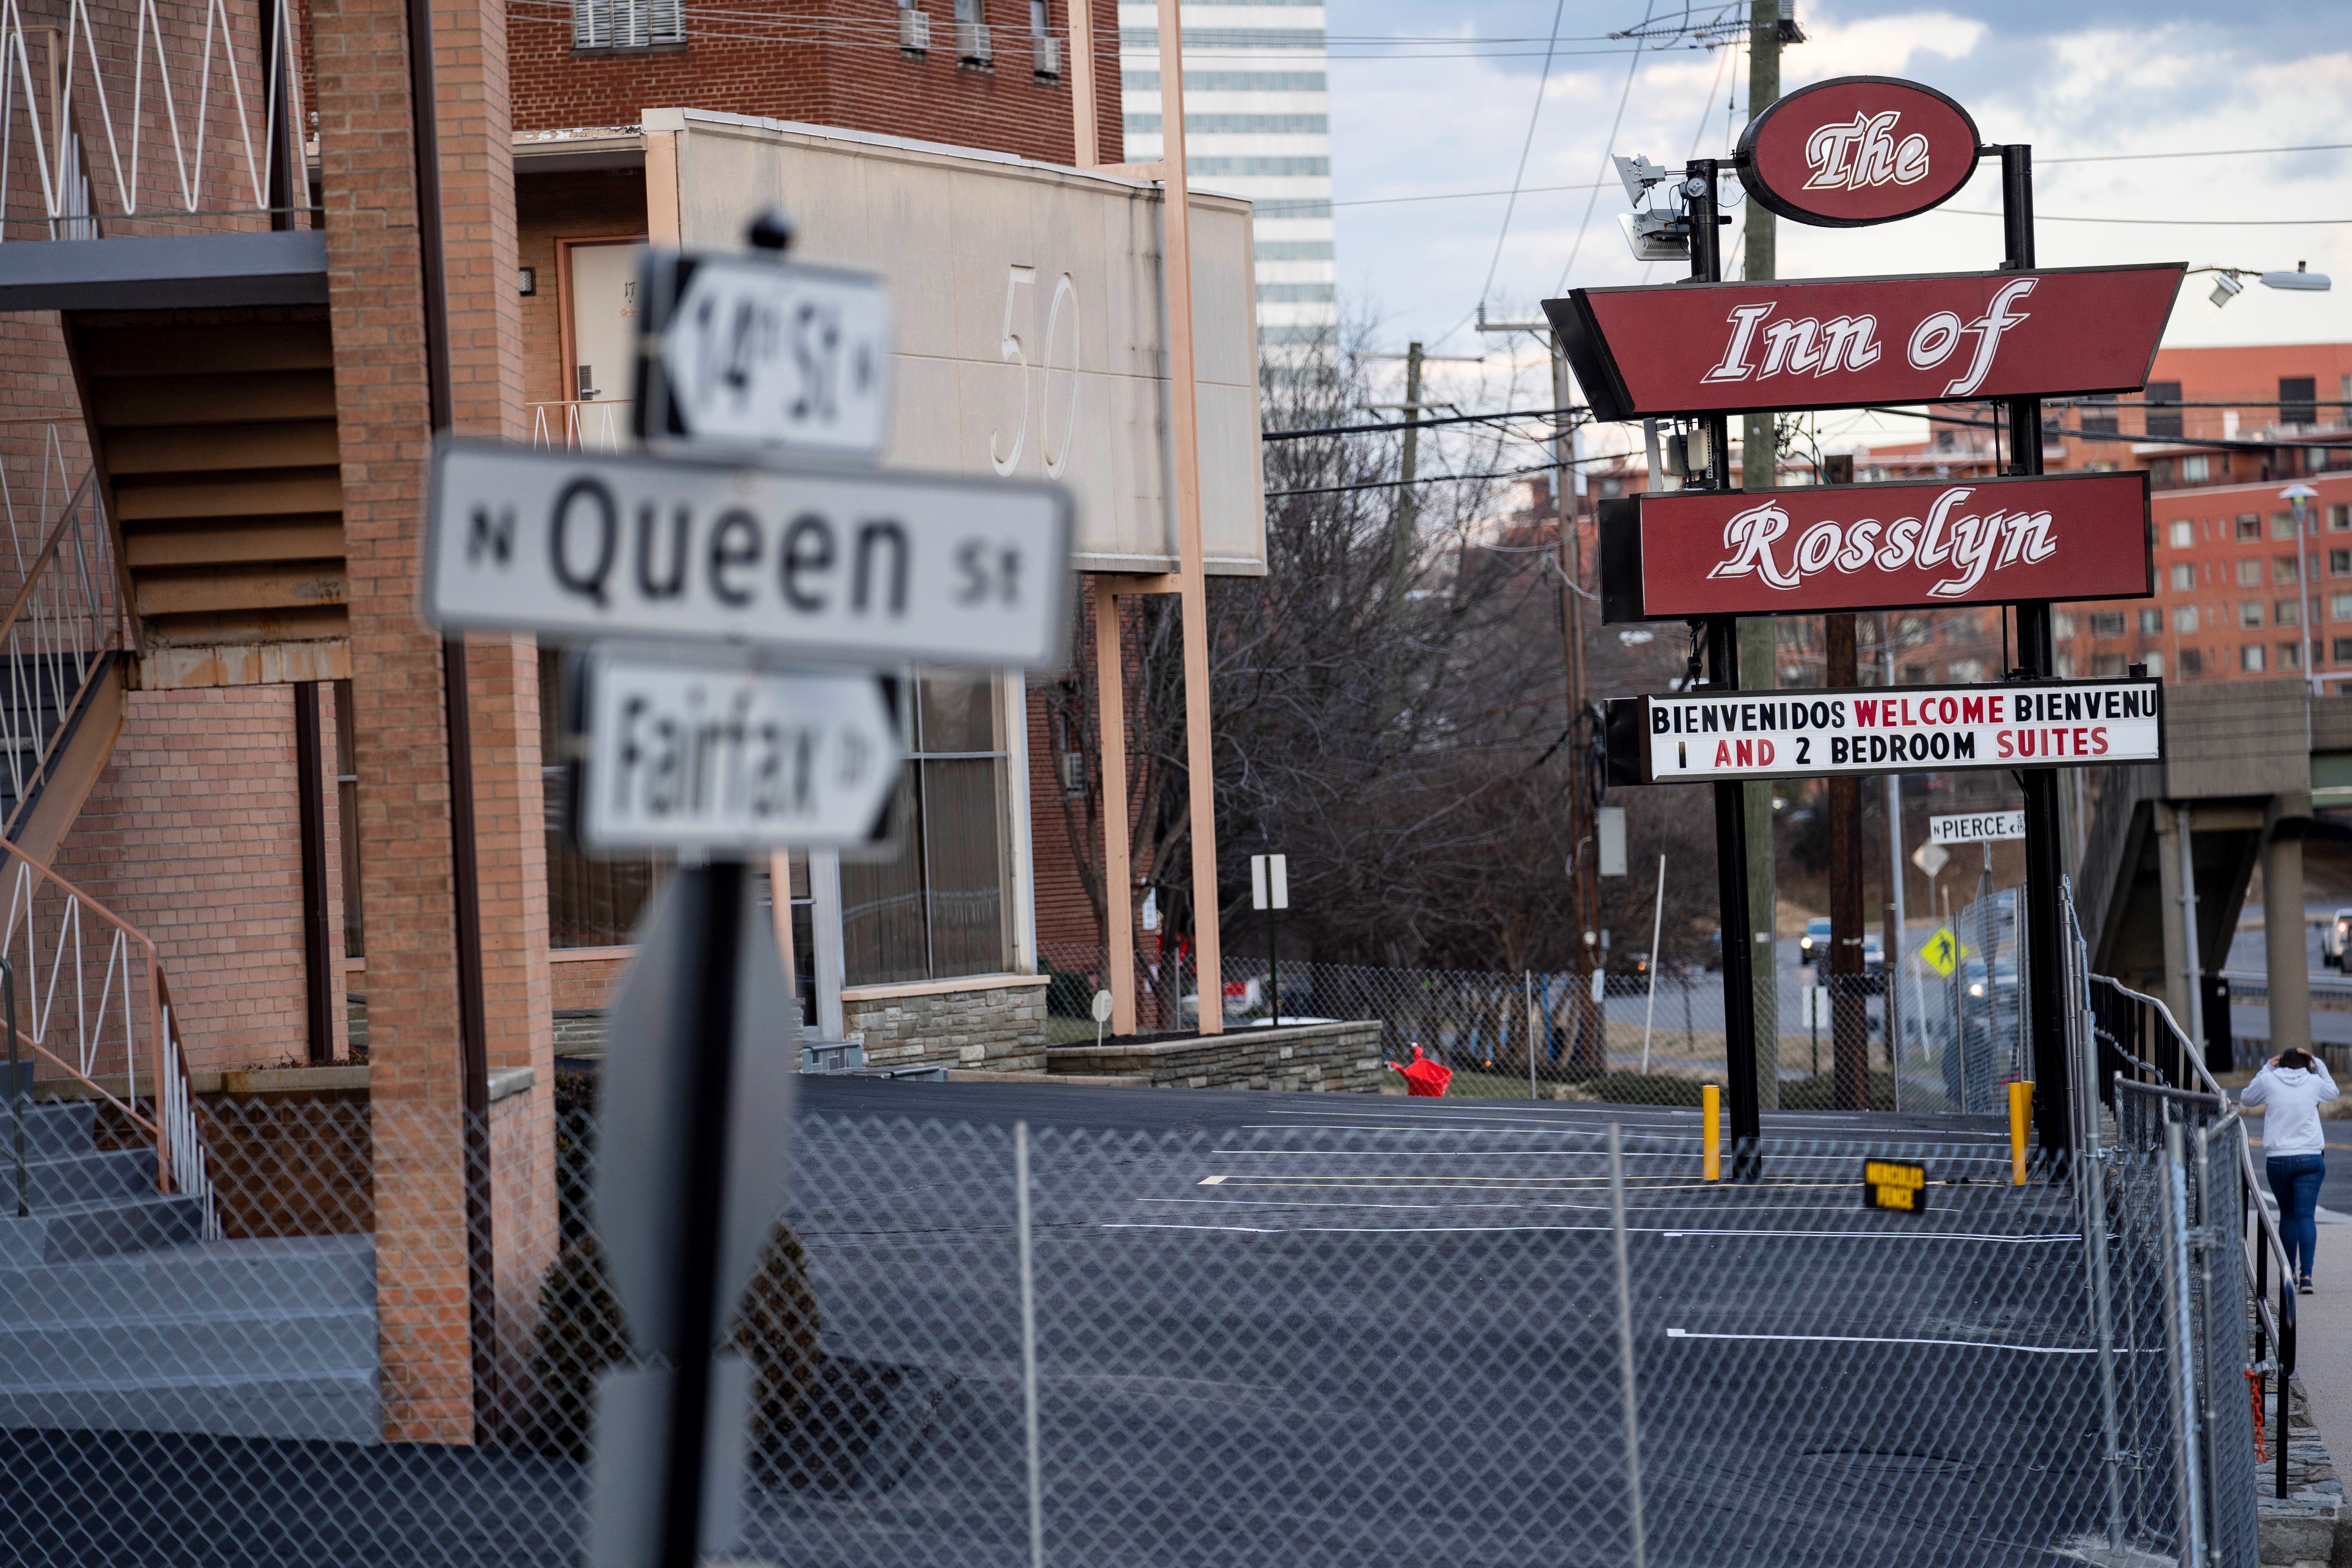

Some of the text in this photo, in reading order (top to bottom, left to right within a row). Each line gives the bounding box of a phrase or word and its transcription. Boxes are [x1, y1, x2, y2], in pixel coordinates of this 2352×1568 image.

[1802, 111, 1929, 191] The
[625, 281, 635, 298] 17
[1700, 278, 2039, 397] Inn of
[466, 474, 1024, 619] N Queen St
[1706, 487, 2057, 598] Rosslyn
[1652, 690, 2156, 734] BIENVENIDOS WELCOME BIENVENU
[1714, 739, 1775, 767] AND
[1795, 737, 1811, 764] 2
[1831, 731, 1975, 764] BEDROOM
[1997, 727, 2108, 758] SUITES
[1934, 816, 2006, 838] N PIERCE
